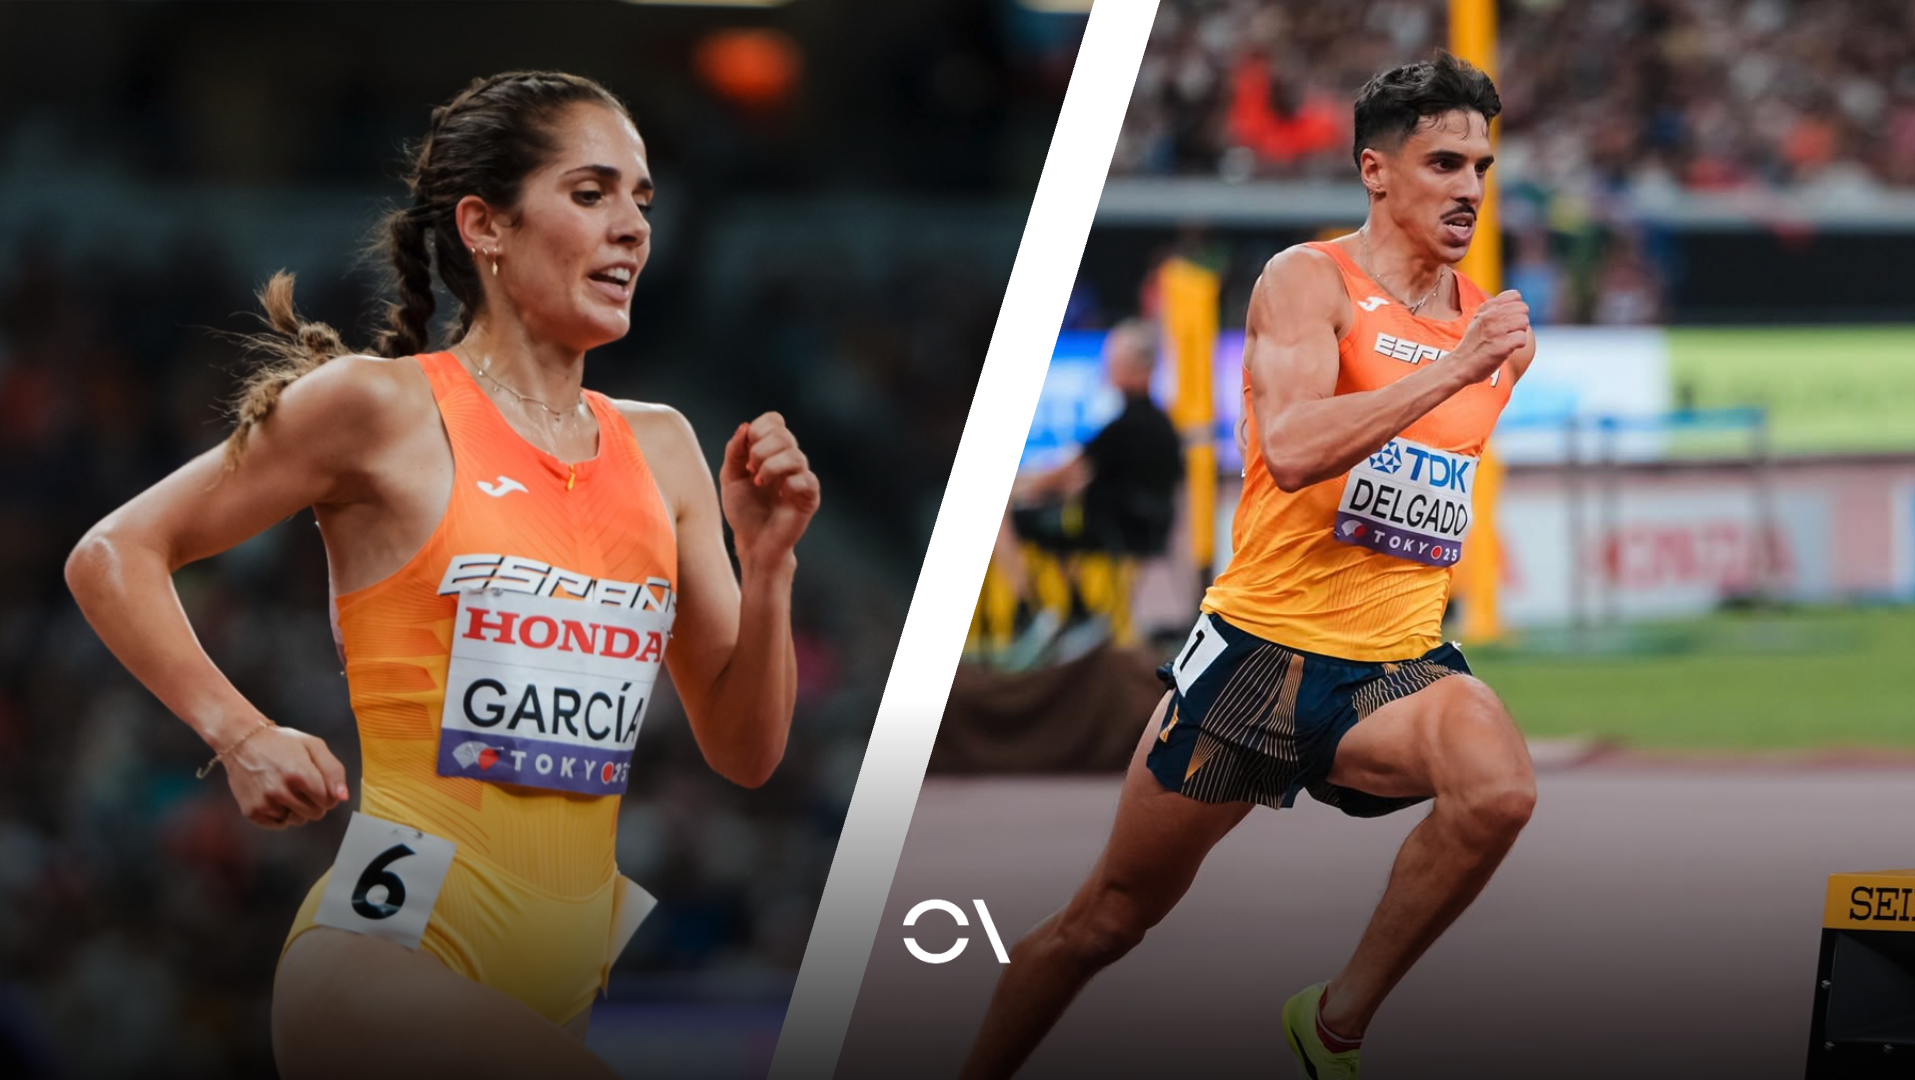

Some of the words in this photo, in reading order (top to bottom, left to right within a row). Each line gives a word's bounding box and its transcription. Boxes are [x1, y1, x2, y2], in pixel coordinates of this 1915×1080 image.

[1405, 446, 1470, 493] TDK
[1349, 478, 1468, 536] DELGADO
[437, 554, 677, 613] ESPAÑ
[462, 606, 664, 664] HONDA
[1179, 629, 1205, 673] 1
[462, 678, 645, 743] GARCÍA
[352, 843, 417, 920] 6
[1849, 886, 1915, 922] SEI
